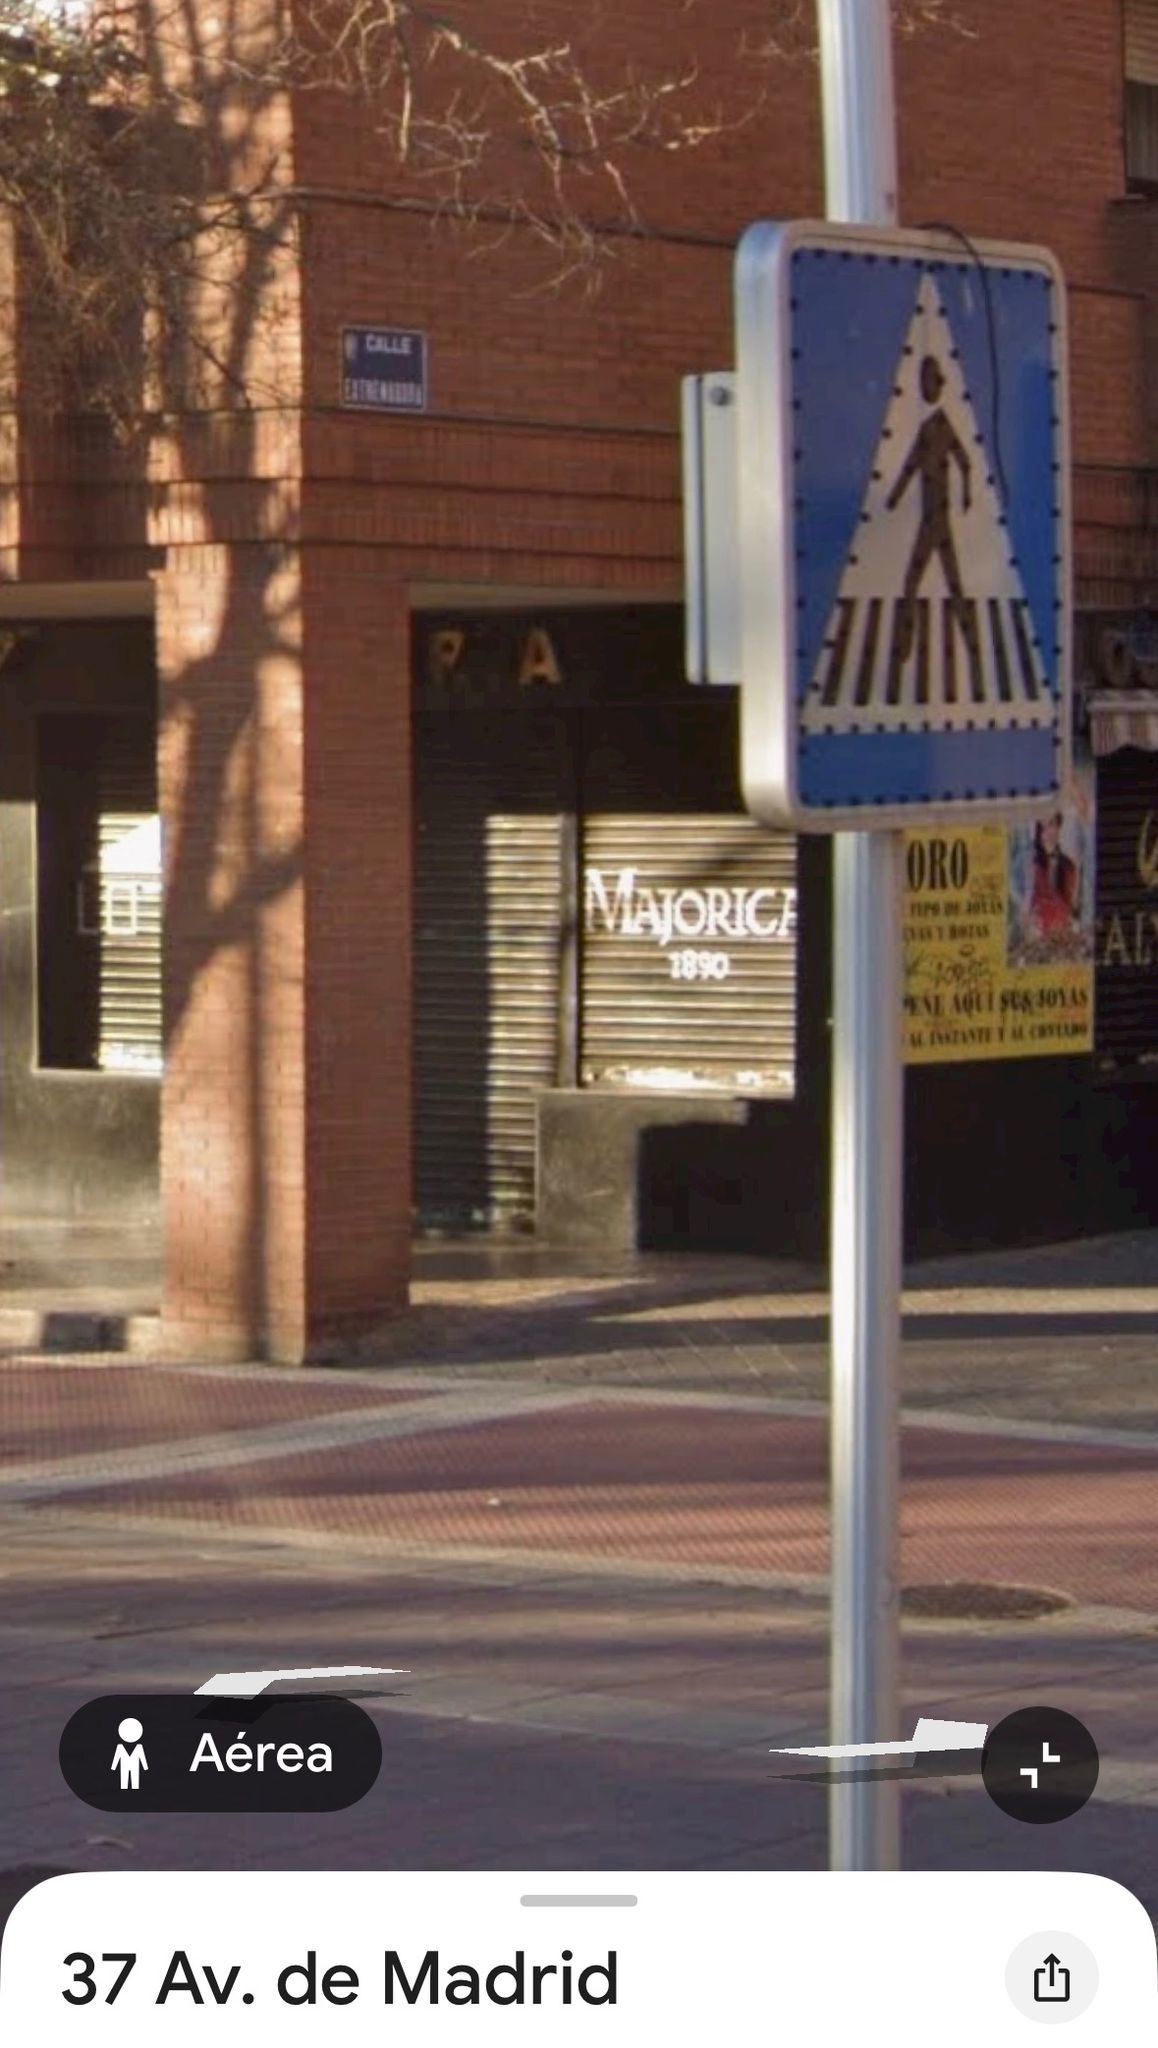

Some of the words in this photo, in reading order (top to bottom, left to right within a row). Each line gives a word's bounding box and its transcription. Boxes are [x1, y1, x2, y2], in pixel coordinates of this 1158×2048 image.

[365, 333, 411, 354] CALLE
[907, 838, 968, 890] ORO
[667, 949, 730, 980] 1890
[1036, 986, 1088, 1009] JOYAS
